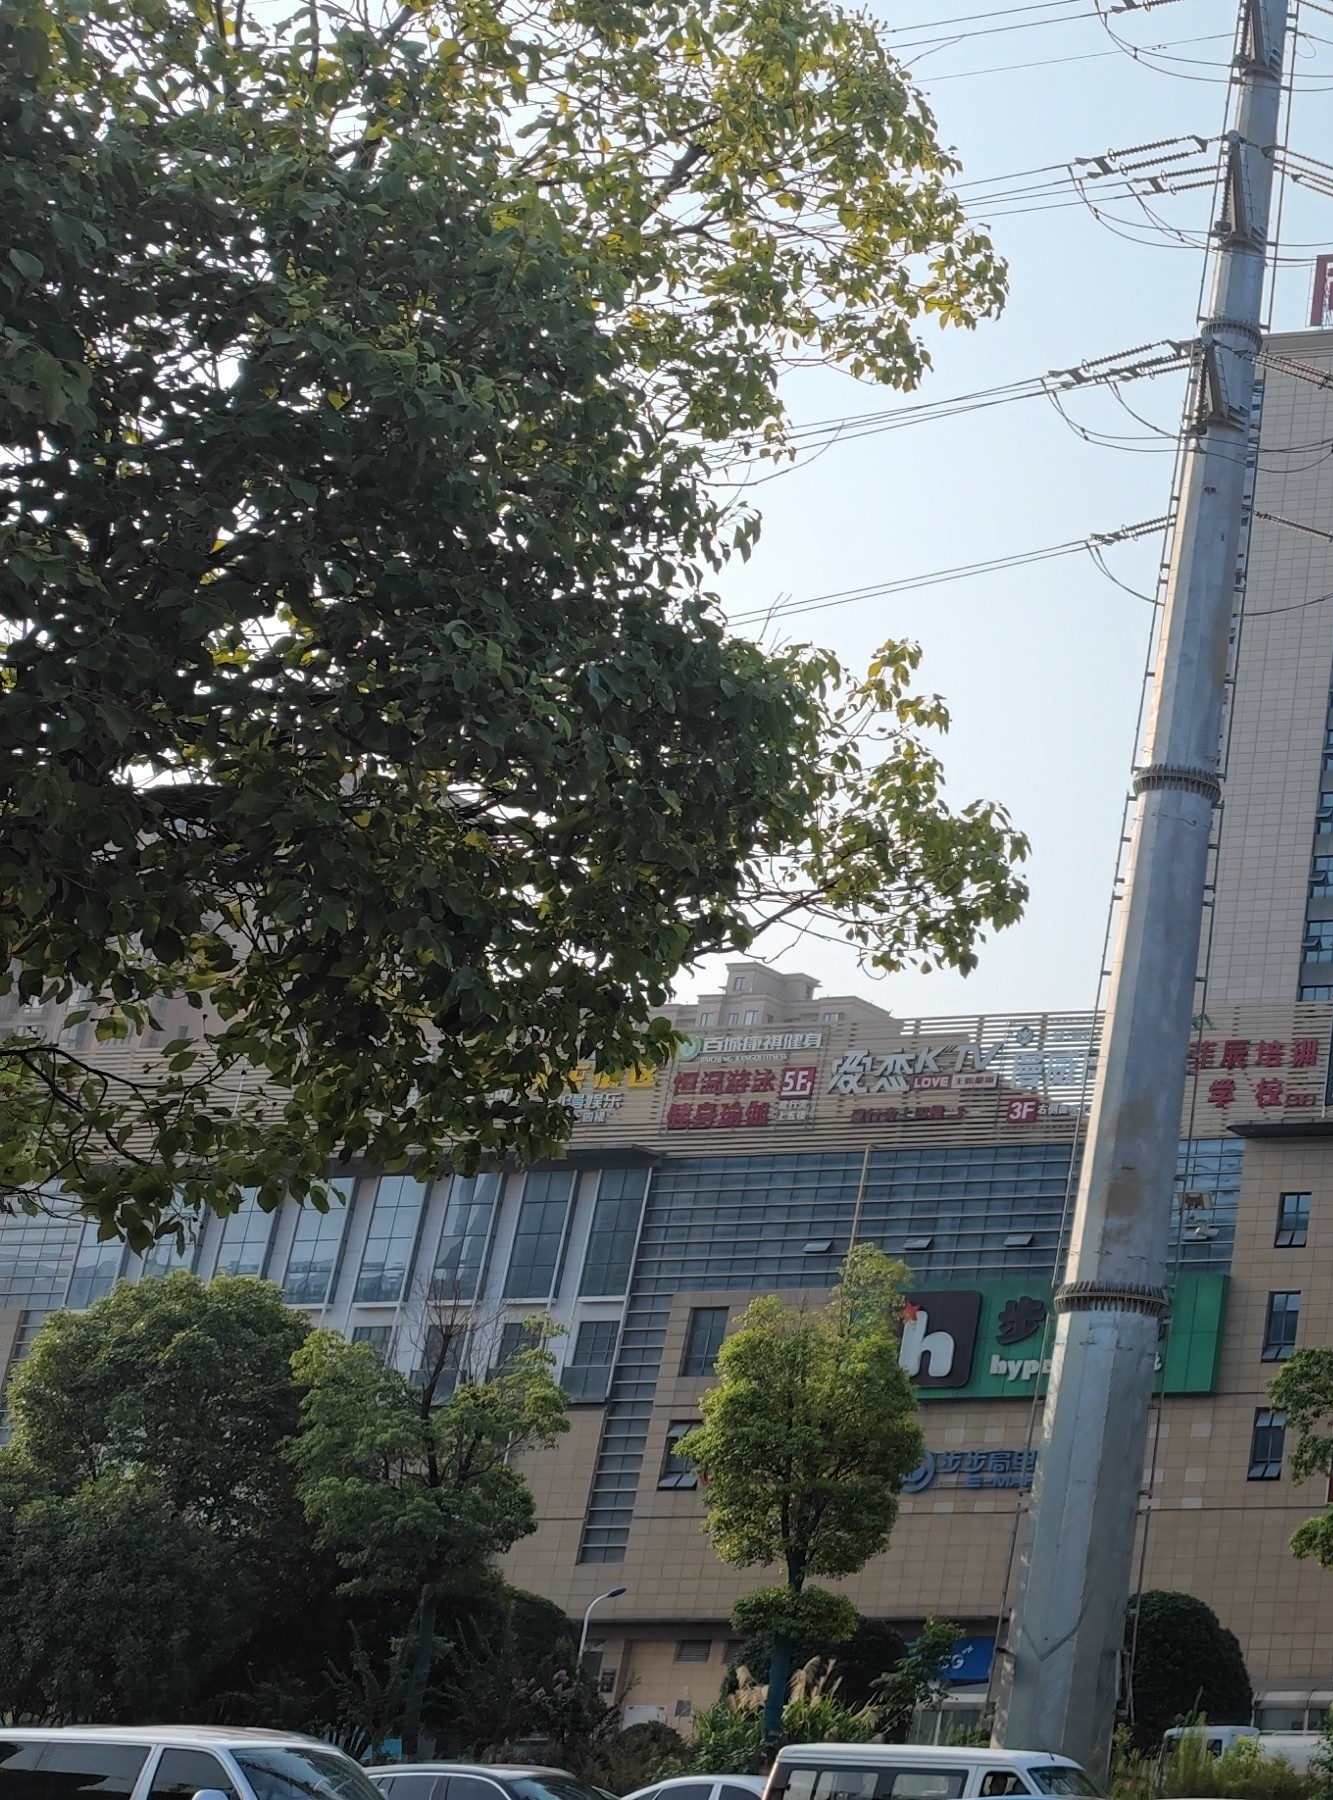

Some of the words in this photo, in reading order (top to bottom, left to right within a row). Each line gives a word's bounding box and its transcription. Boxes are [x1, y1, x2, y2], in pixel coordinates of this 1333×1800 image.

[674, 1069, 775, 1095] 恒温游泳
[782, 1070, 810, 1092] 5F
[913, 1076, 949, 1088] LOVE
[1208, 1077, 1283, 1109] 学校
[1009, 1102, 1035, 1120] 3F
